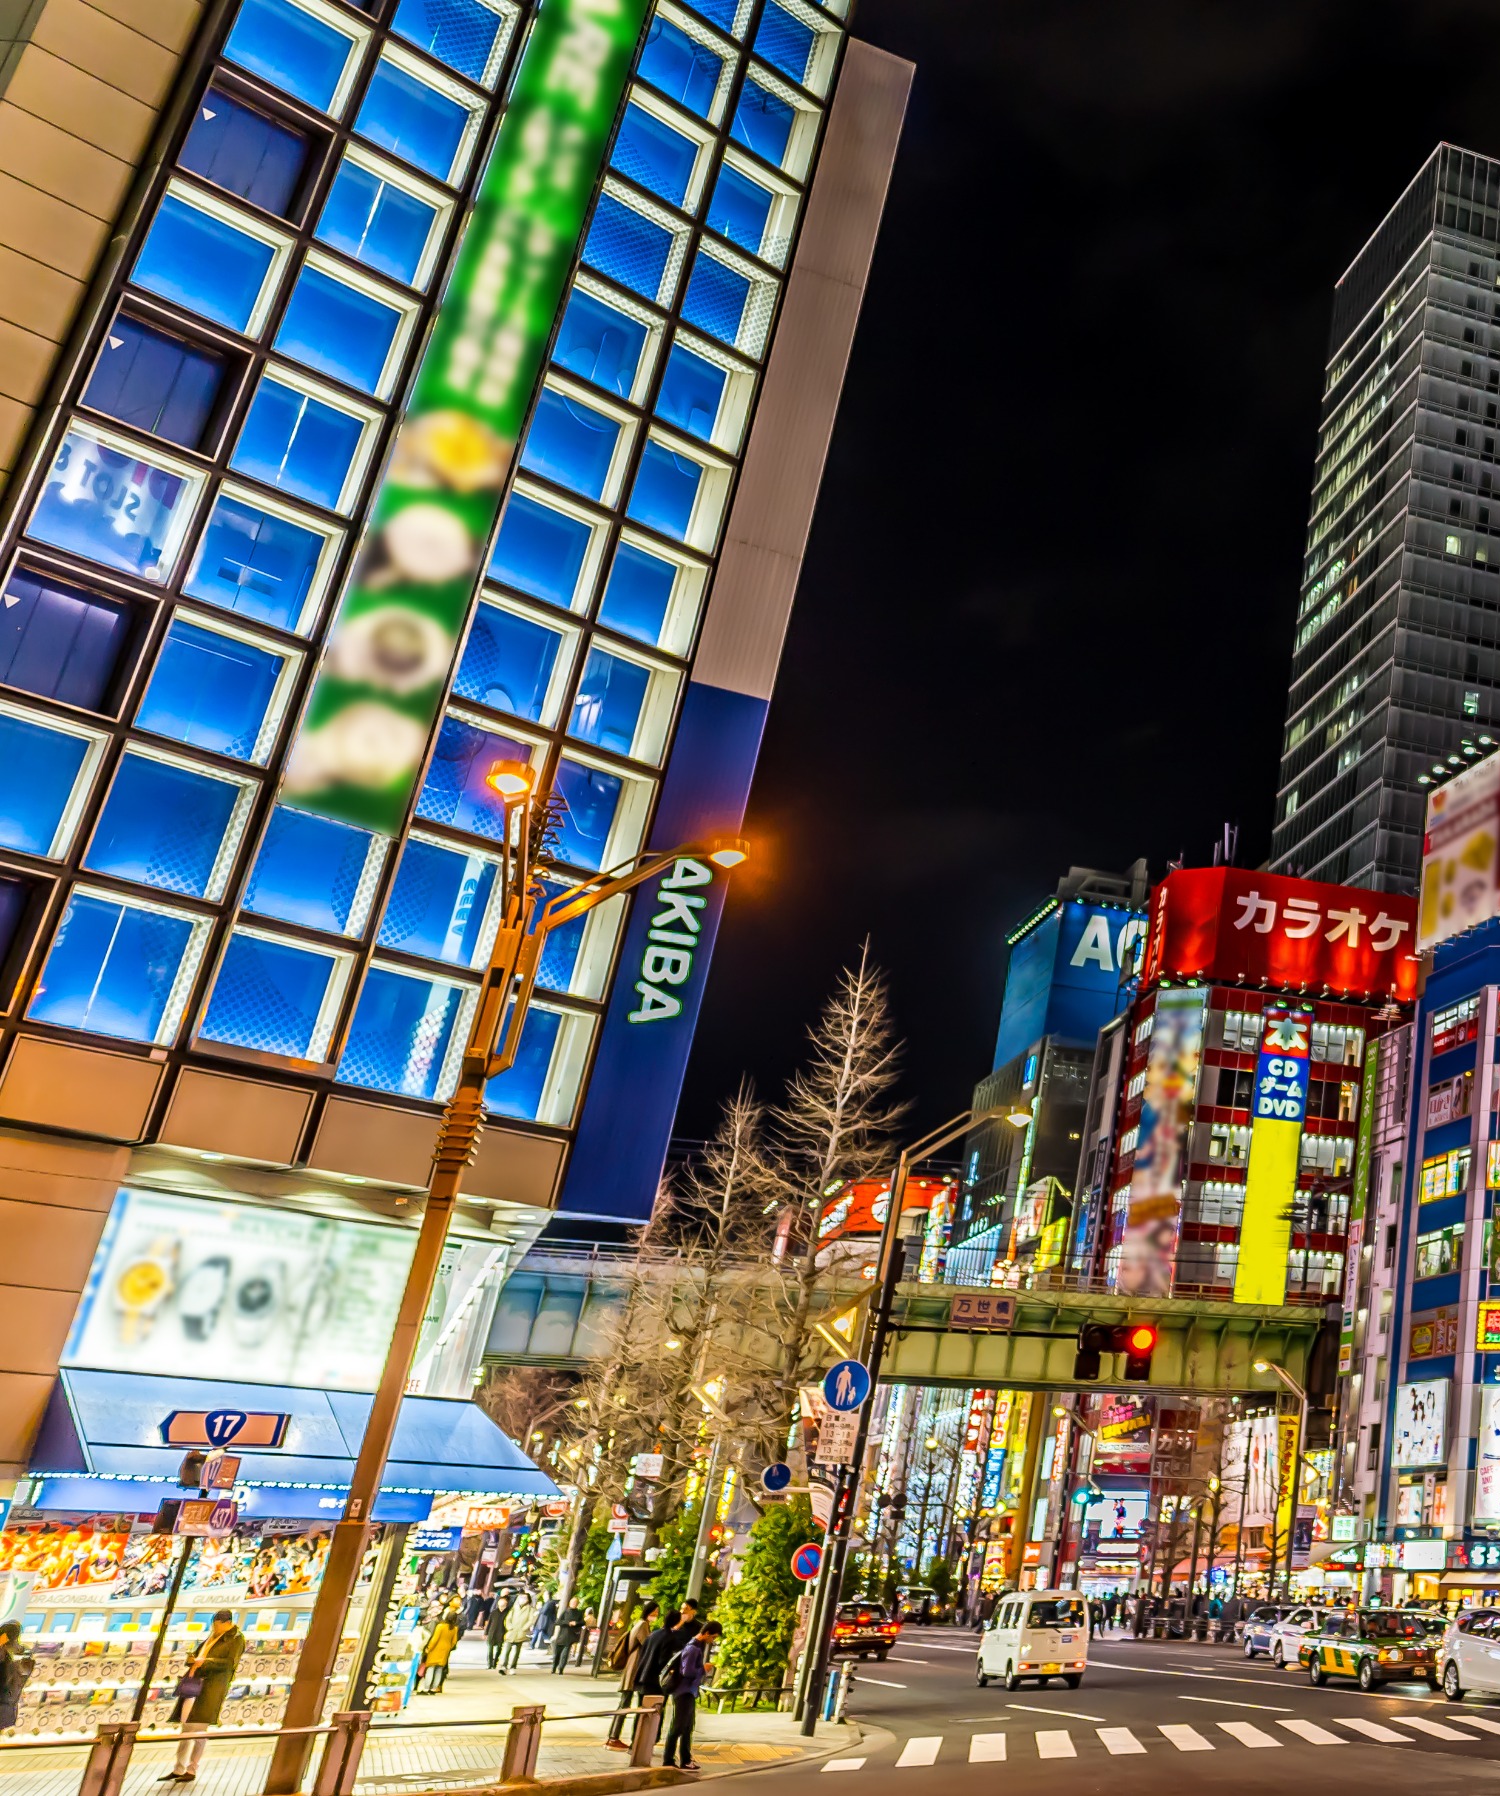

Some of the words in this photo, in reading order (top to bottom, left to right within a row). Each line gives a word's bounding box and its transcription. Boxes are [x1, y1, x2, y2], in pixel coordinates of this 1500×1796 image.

[1233, 890, 1410, 952] カラオケ
[628, 858, 713, 1024] AKIBA
[1264, 1016, 1309, 1052] 本
[1267, 1058, 1299, 1077] CD
[1259, 1076, 1303, 1098] ゲーム
[1258, 1096, 1300, 1118] DVD
[957, 1299, 1010, 1314] 万世橋
[212, 1414, 242, 1438] 17
[191, 1592, 243, 1606] GUNDAM
